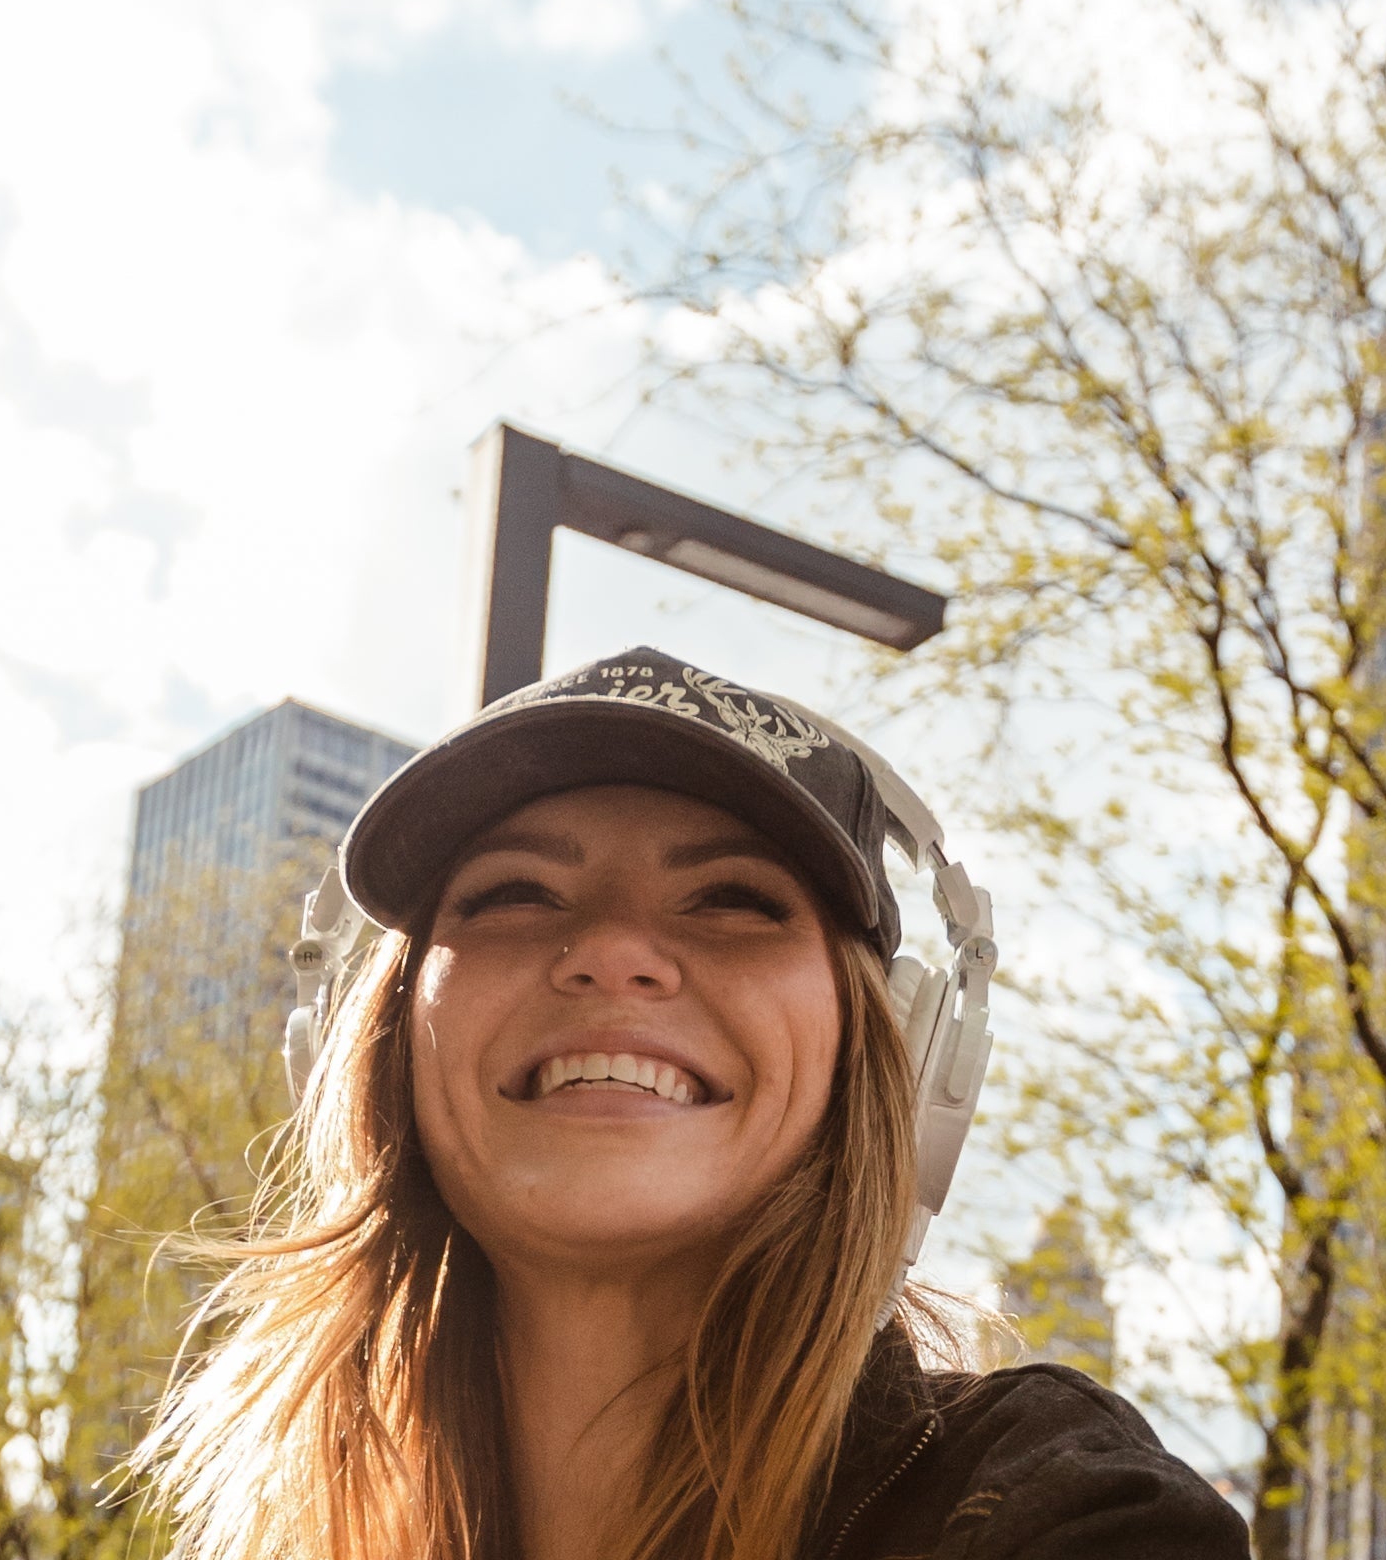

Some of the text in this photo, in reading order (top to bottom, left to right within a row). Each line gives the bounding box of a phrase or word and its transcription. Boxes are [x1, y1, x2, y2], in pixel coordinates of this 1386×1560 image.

[599, 665, 654, 679] 1878
[303, 951, 313, 963] R
[975, 947, 984, 959] L
